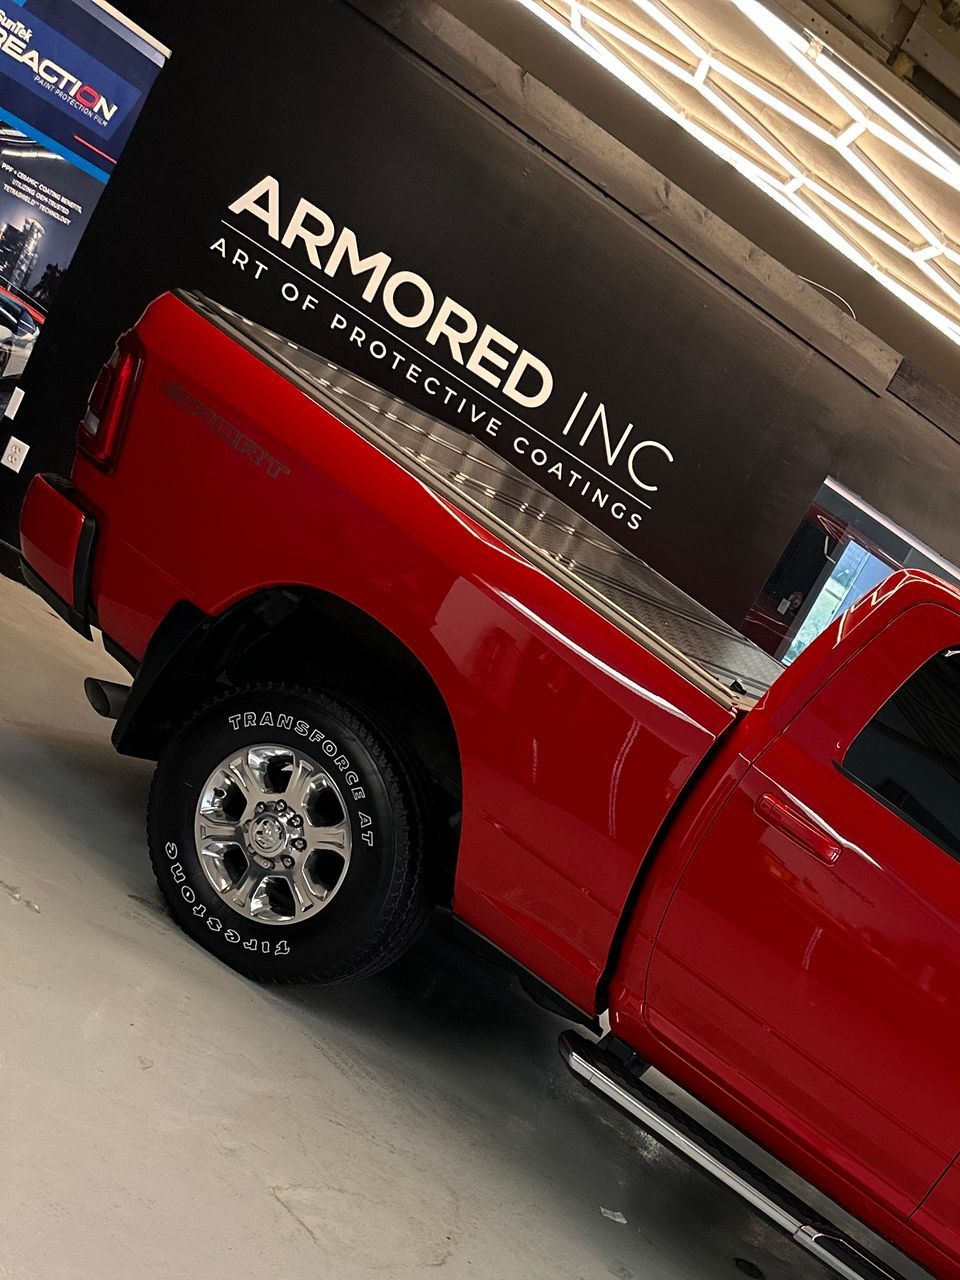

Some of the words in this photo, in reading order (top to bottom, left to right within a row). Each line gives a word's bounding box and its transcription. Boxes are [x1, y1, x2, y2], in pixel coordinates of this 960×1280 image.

[33, 75, 55, 92] PAINT
[54, 87, 93, 117] PROTECTION
[93, 113, 108, 127] FILM
[1, 162, 14, 173] PPF
[17, 171, 39, 188] CERAMIC
[38, 183, 62, 201] COATING
[210, 238, 269, 280] ART
[281, 282, 319, 311] OF
[330, 313, 502, 437] PROTECTIVE
[513, 436, 643, 530] COATINGS
[228, 175, 554, 409] ARMORED
[562, 391, 674, 492] INC
[228, 711, 366, 801] TRANSFORCE
[358, 811, 374, 847] AT
[165, 842, 291, 956] Firestone
